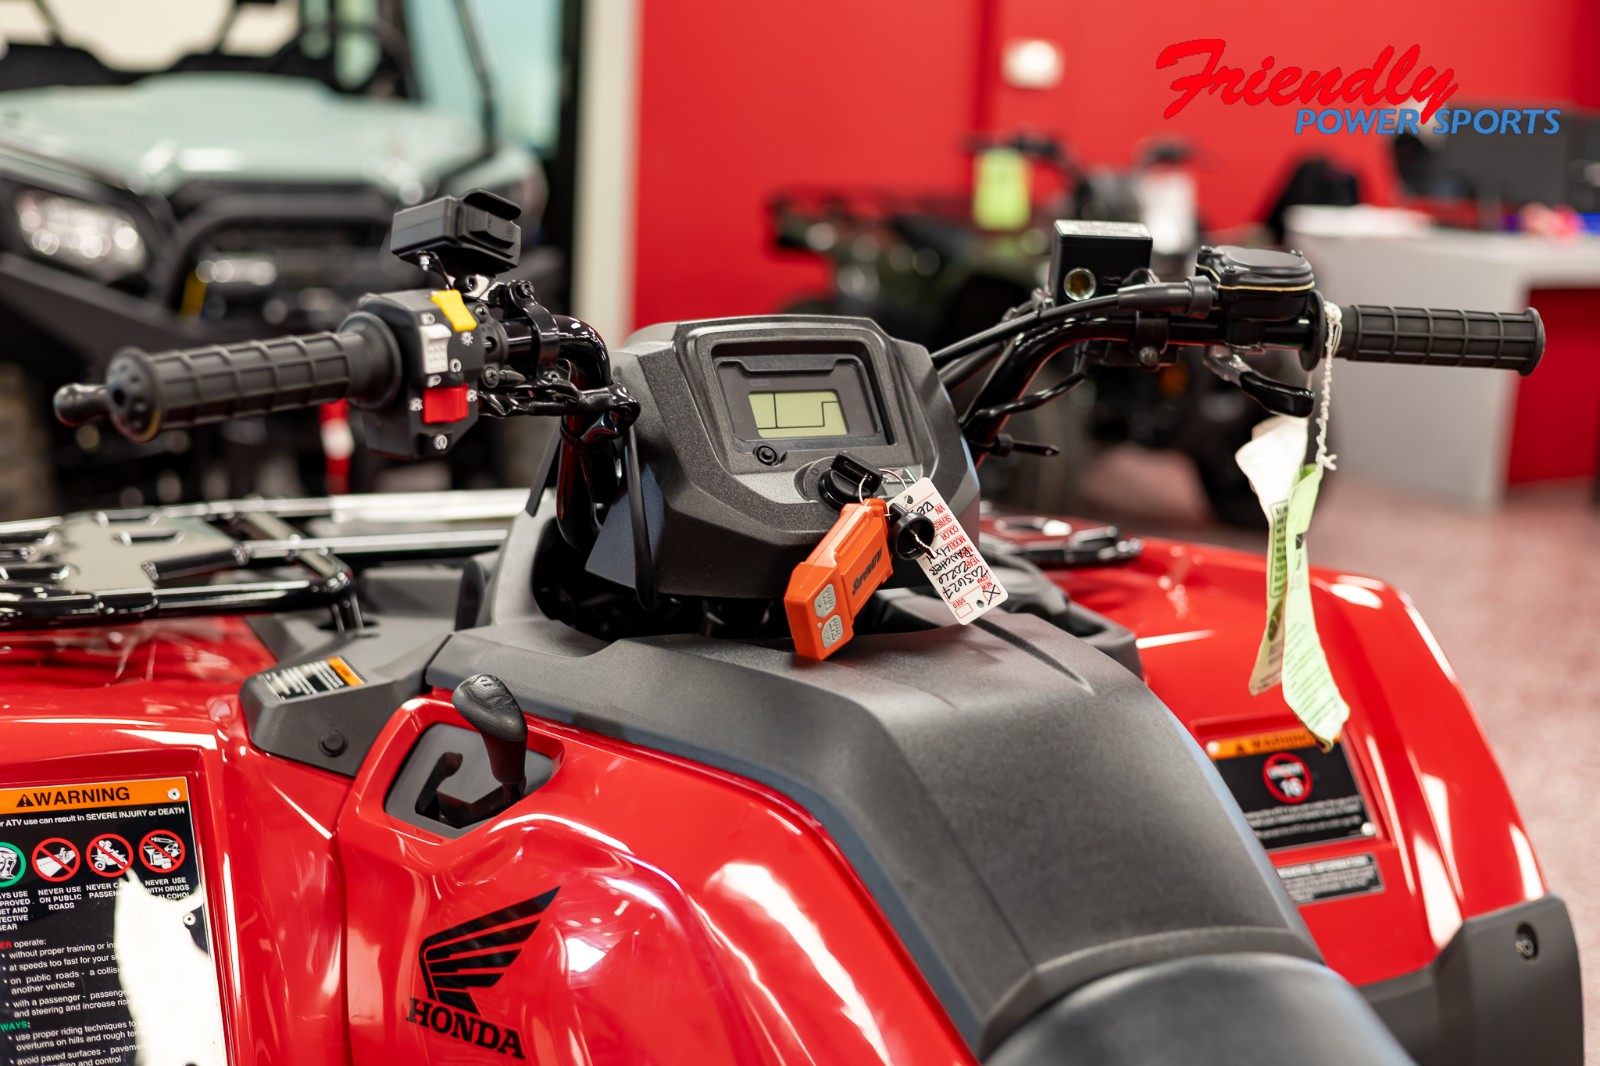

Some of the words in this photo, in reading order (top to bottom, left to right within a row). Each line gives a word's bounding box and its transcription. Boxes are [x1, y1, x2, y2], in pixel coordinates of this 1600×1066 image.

[935, 503, 945, 515] VIN
[934, 514, 952, 531] SERIES
[940, 525, 959, 540] COLOR
[950, 534, 966, 549] MODEL
[953, 598, 966, 608] USED
[33, 787, 130, 806] WARNING
[6, 819, 22, 827] ATV
[54, 815, 76, 823] result
[86, 812, 118, 820] SEVERE
[119, 810, 147, 819] INJURY
[158, 808, 185, 816] DEATH
[86, 883, 111, 891] NEVER
[144, 878, 169, 886] NEVER
[164, 884, 190, 892] DRUGS
[38, 887, 64, 896] NEVER
[66, 886, 82, 894] USE
[89, 890, 119, 899] PASSEN
[39, 896, 51, 904] ON
[53, 894, 82, 902] PUBLIC
[48, 902, 75, 911] ROADS
[14, 939, 47, 948] operate:
[9, 949, 38, 959] without
[39, 948, 65, 957] proper
[66, 944, 95, 953] training
[19, 961, 48, 971] speeds
[63, 957, 79, 965] fast
[92, 955, 110, 964] your
[26, 973, 52, 983] public
[55, 971, 80, 980] roads
[11, 985, 44, 995] another
[46, 981, 75, 991] vehicle
[13, 1000, 30, 1008] with
[39, 994, 81, 1006] passenger
[90, 990, 128, 1000] passenge
[14, 1009, 30, 1018] and
[31, 1006, 64, 1016] steering
[65, 1003, 81, 1012] and
[82, 1001, 116, 1010] increase
[32, 1031, 59, 1041] proper
[61, 1027, 83, 1036] riding
[84, 1022, 127, 1032] techniques
[406, 998, 526, 1061] HONDA
[16, 1041, 55, 1051] overturns
[68, 1036, 85, 1044] hills
[86, 1035, 101, 1043] and
[103, 1031, 125, 1042] rough
[17, 1056, 39, 1066] avoid
[41, 1052, 66, 1064] paved
[67, 1048, 101, 1059] surfaces
[110, 1044, 143, 1055] paveme
[95, 1056, 122, 1065] control
